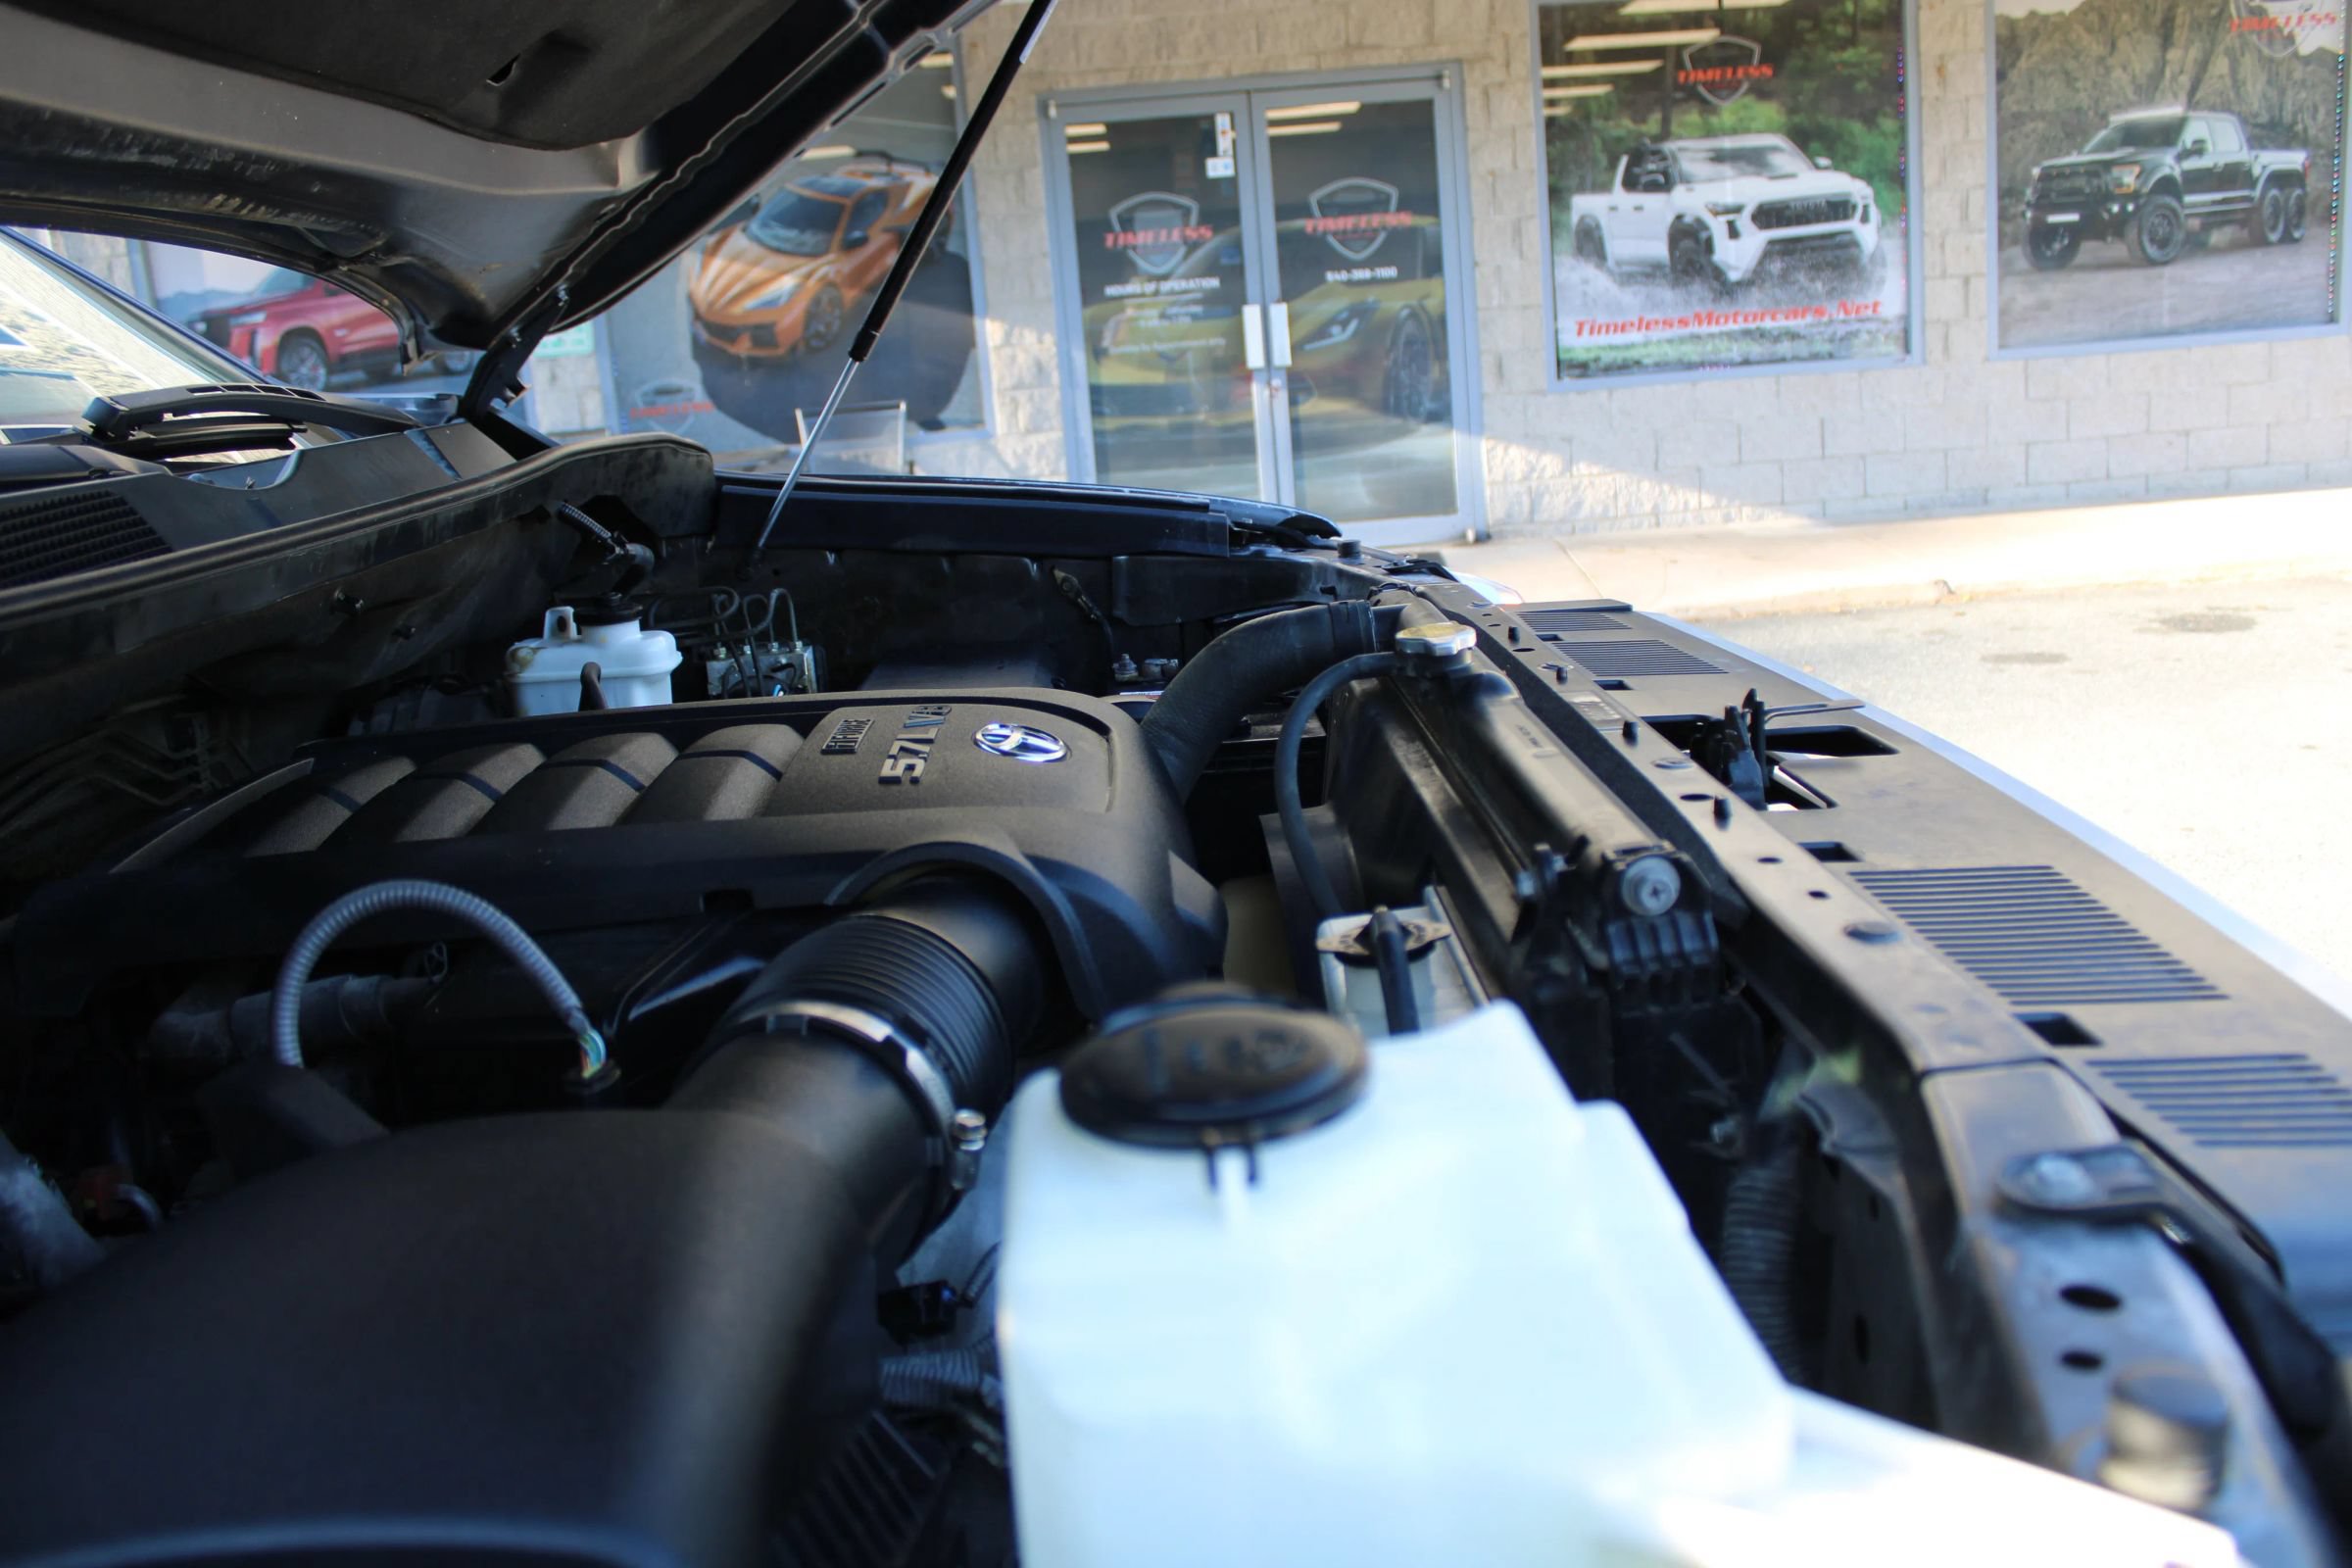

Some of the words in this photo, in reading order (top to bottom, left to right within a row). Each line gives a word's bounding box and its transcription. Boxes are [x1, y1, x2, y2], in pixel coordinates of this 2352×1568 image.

[1678, 63, 1774, 85] TIMELESS
[1304, 210, 1412, 234] TIMELESS
[1103, 223, 1213, 249] TIMELESS
[1159, 275, 1220, 293] OPERATION
[1575, 299, 1882, 338] TimelessMotorcars.Net
